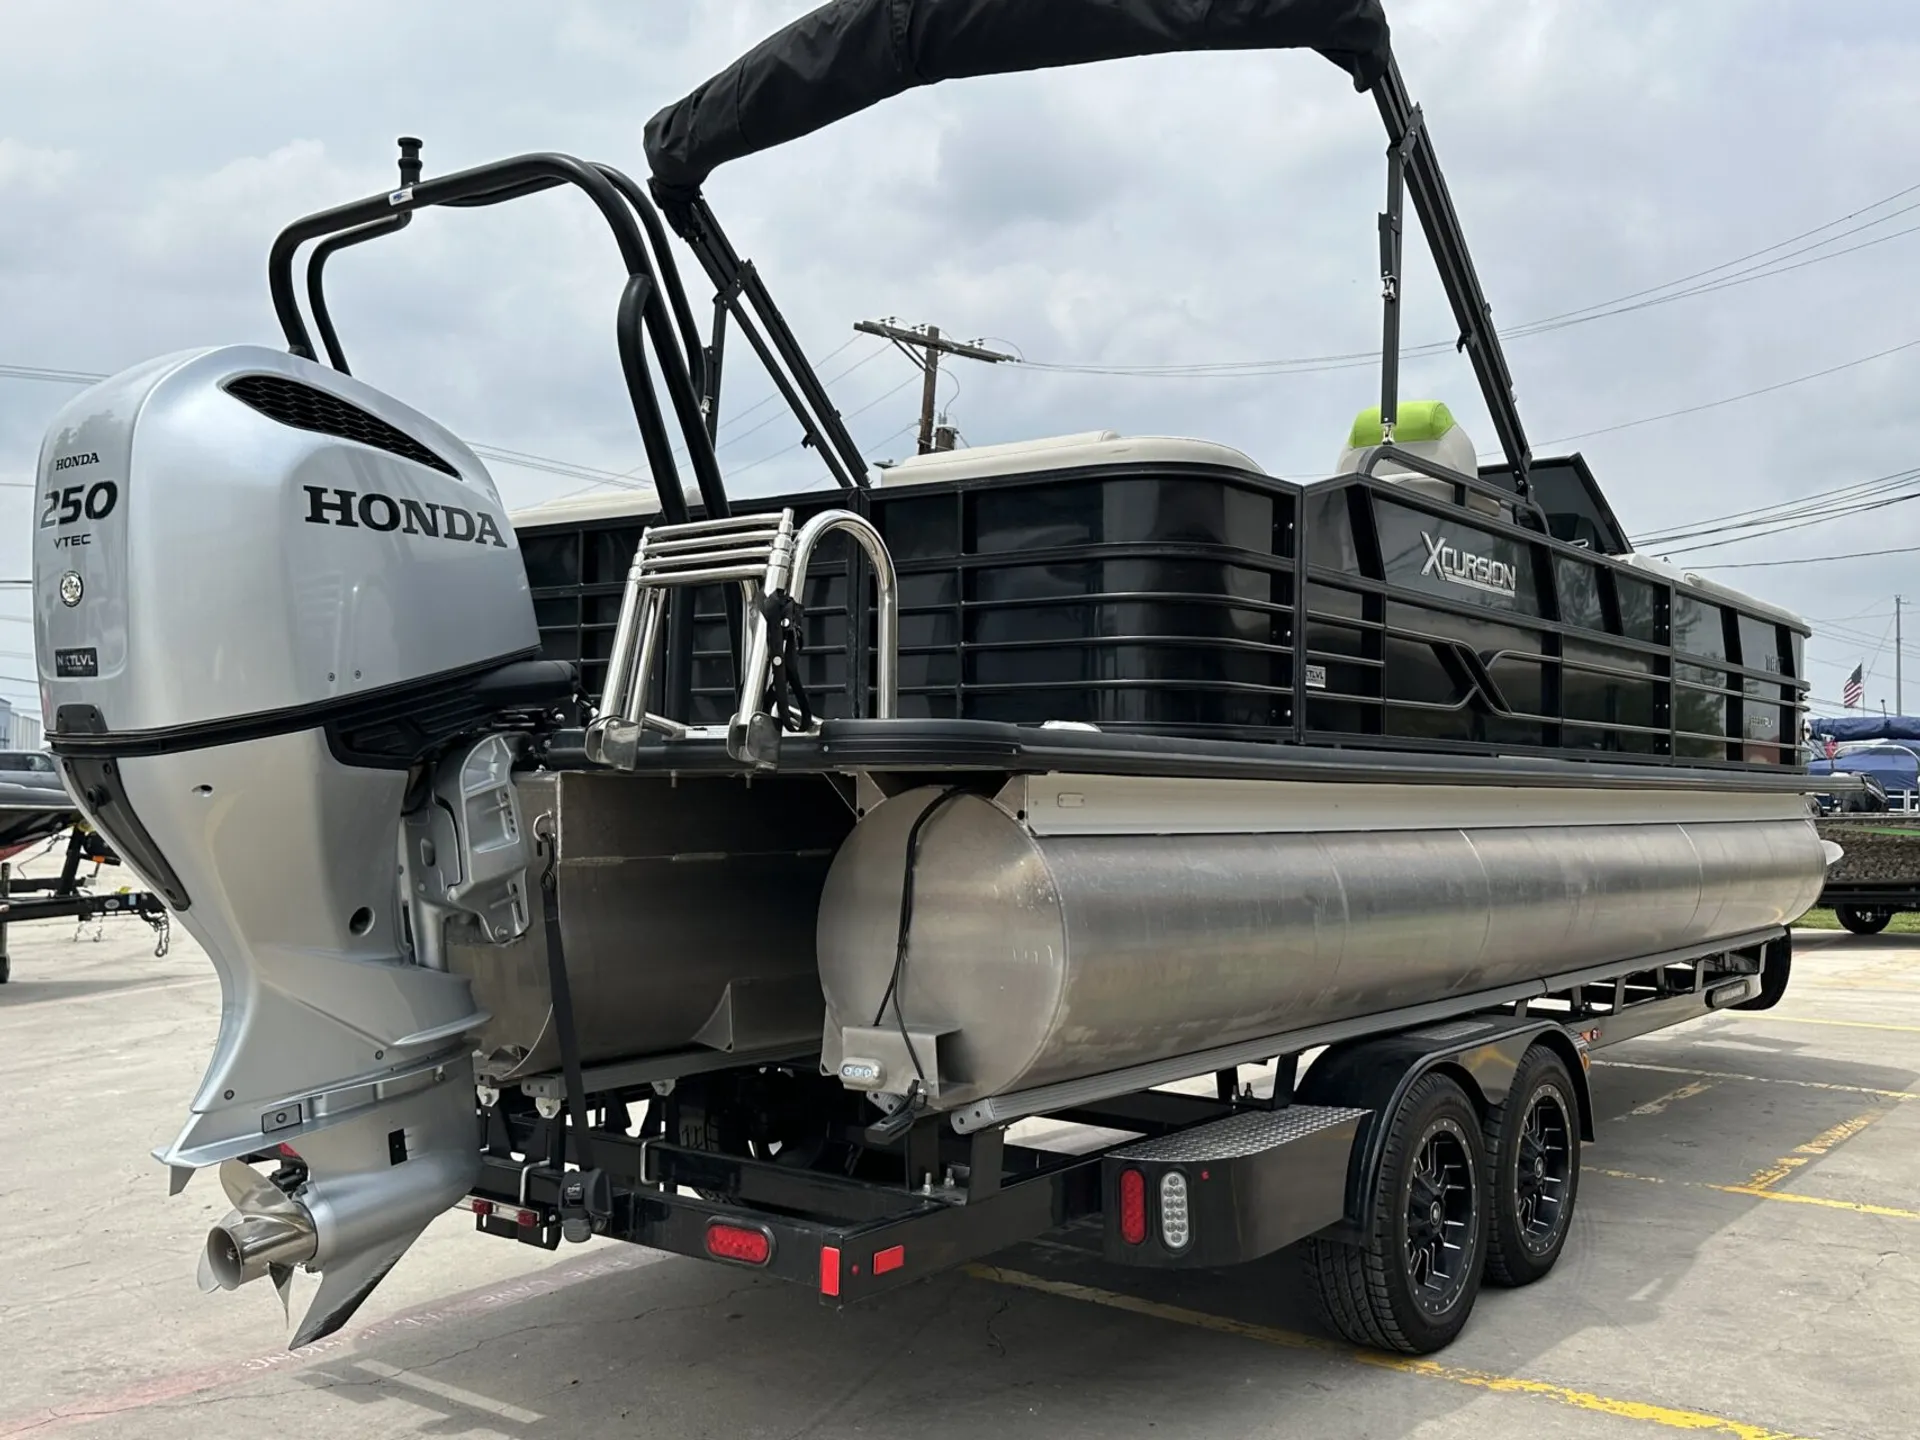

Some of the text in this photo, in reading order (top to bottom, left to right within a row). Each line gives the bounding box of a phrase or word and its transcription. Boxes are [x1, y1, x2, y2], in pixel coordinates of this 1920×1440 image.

[55, 452, 100, 471] HONDA
[40, 480, 118, 529] 250
[303, 485, 508, 548] HONDA
[53, 533, 92, 549] VTEC
